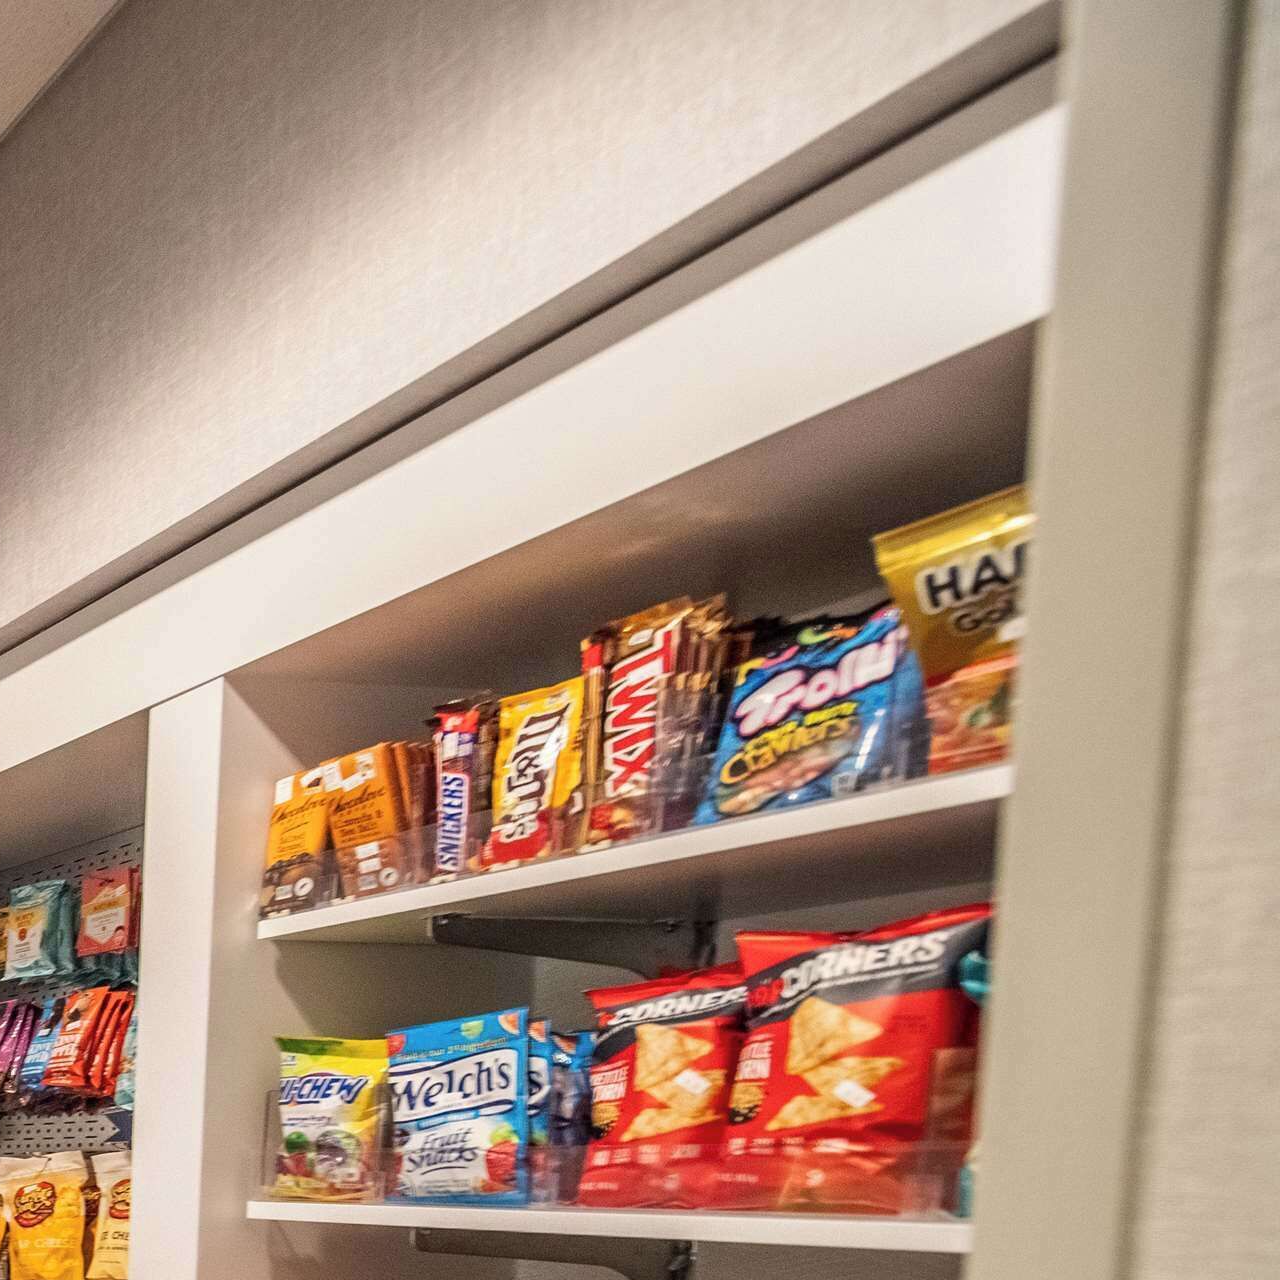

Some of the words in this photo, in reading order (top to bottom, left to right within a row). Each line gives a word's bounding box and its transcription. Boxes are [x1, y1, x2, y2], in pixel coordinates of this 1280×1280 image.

[438, 775, 466, 866] SNICKERS
[391, 1057, 512, 1111] Welch's
[423, 1127, 472, 1151] Fruit
[407, 1147, 478, 1173] Snacks
